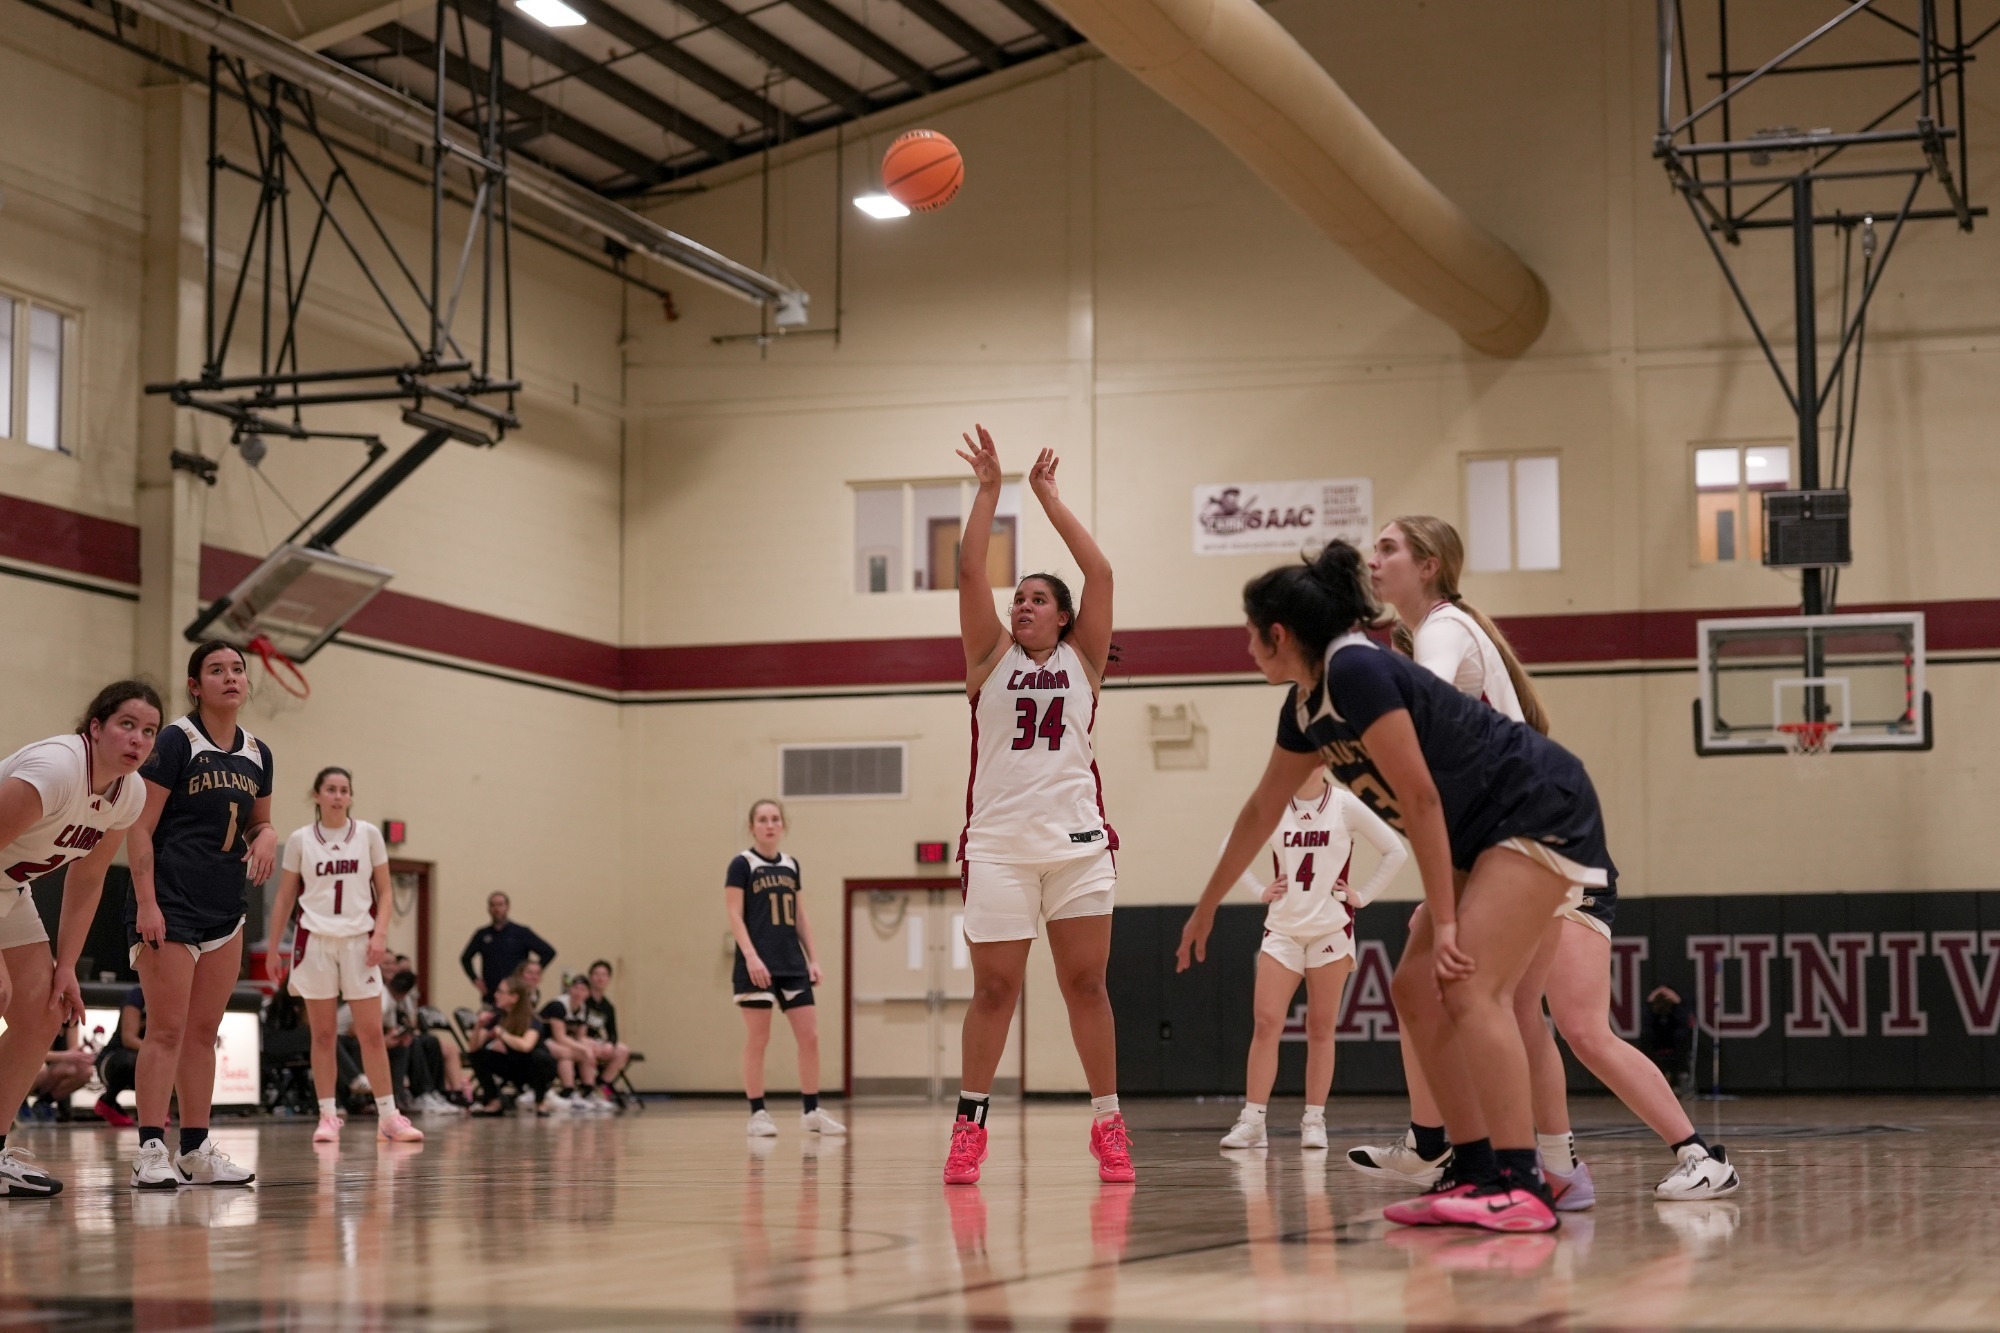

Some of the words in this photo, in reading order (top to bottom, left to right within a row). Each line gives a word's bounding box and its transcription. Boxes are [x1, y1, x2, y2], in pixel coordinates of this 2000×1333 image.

[1246, 506, 1314, 530] SAAC
[1006, 669, 1070, 691] CAIRN
[1011, 696, 1067, 751] 34
[220, 801, 239, 852] 1
[1284, 830, 1331, 848] CAIRN
[315, 859, 359, 877] CAIRN
[1295, 852, 1316, 892] 4
[333, 879, 344, 915] 1
[1686, 930, 2000, 1039] UNIV
